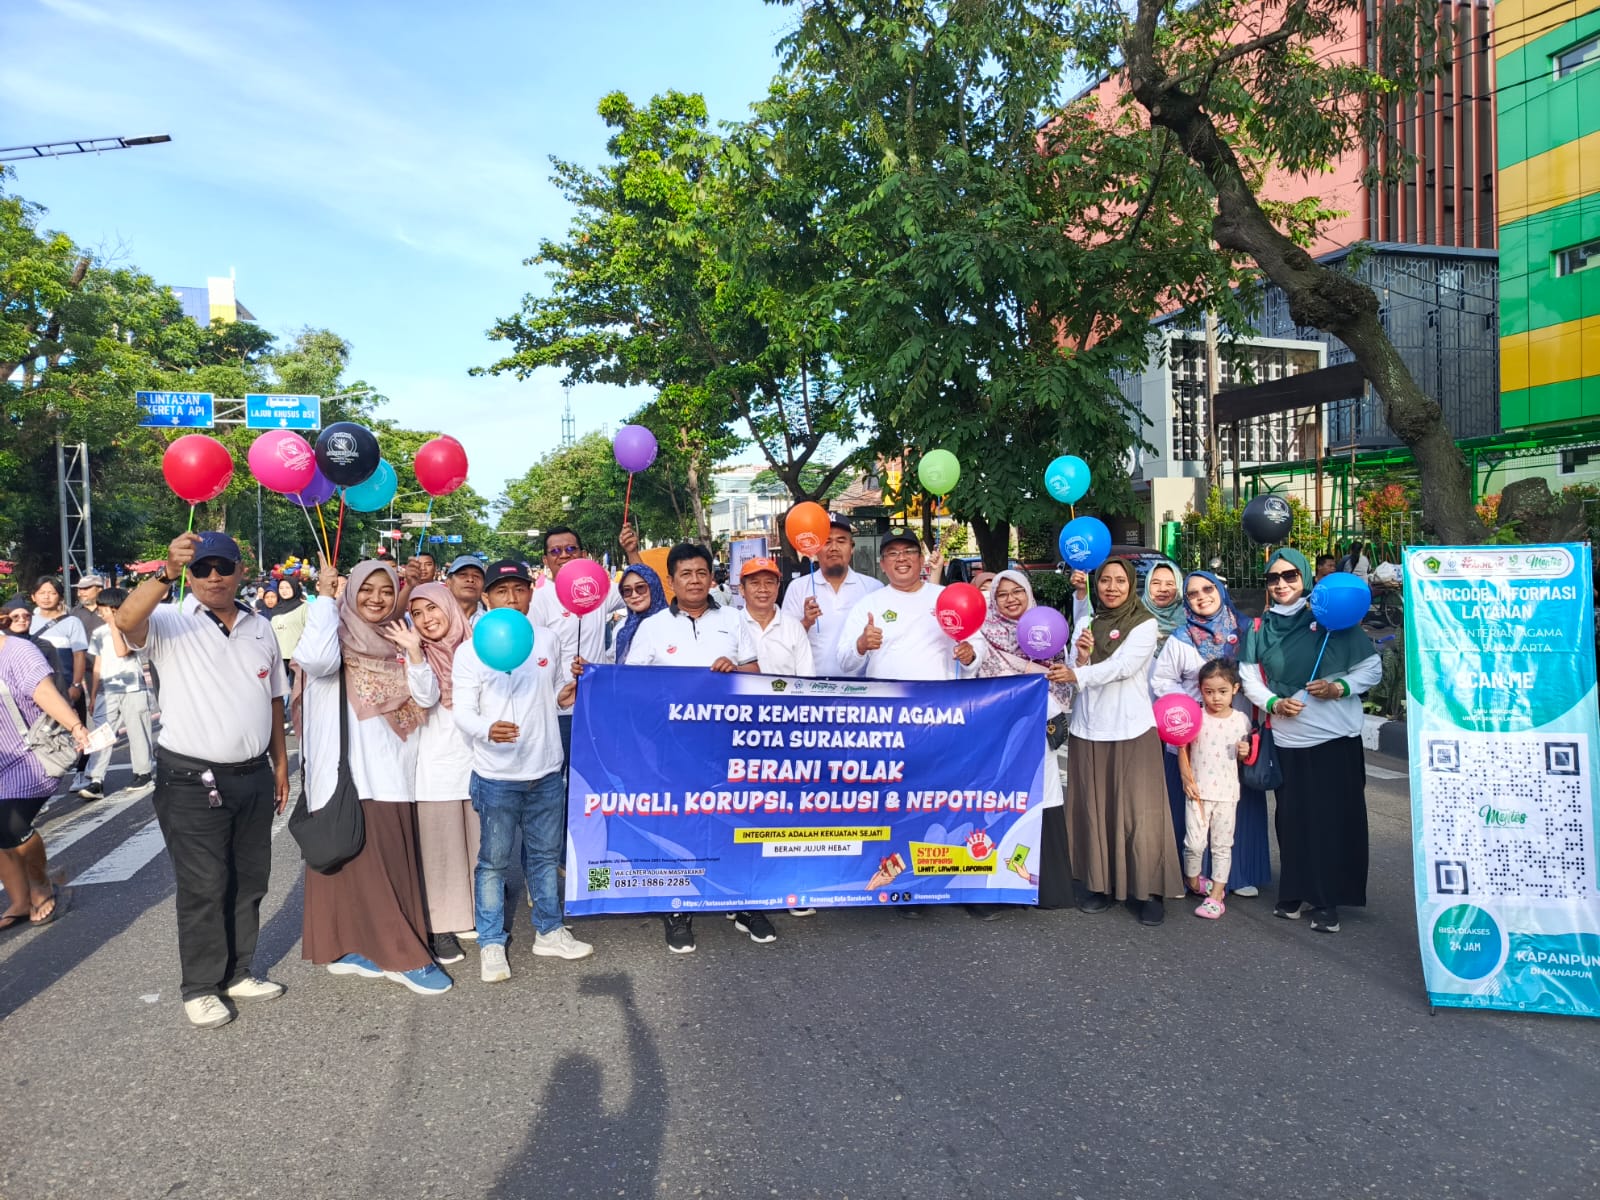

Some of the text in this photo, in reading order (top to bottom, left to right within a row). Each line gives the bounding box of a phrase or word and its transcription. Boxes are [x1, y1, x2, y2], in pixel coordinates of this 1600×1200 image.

[149, 394, 200, 405] LINTASAN
[188, 406, 205, 416] API
[250, 410, 272, 418] LAJUR
[274, 410, 300, 418] KHUSUS
[1423, 586, 1577, 601] BARCODE INFORMASI
[1462, 604, 1533, 619] LAYANAN
[1520, 628, 1563, 638] AGAMA
[1457, 672, 1534, 689] SCAN ME
[669, 703, 966, 725] KANTOR KEMENTERIAN AGAMA
[732, 729, 905, 749] KOTA SURAKARTA
[727, 758, 905, 783] BERANI TOLAK
[584, 790, 1028, 816] PUNGLI, KORUPSI, KOLUSI & NEPOTISME
[742, 831, 786, 839] INTEGRITAS
[820, 830, 858, 838] KEKUATAN
[860, 829, 883, 837] SEJATI
[774, 844, 851, 853] BERANI JUJUR HEBAT
[917, 847, 949, 857] STOP
[1438, 926, 1491, 936] BISA DIAKSES
[1450, 941, 1481, 952] 24 JAM
[1516, 950, 1600, 967] KAPANPUN
